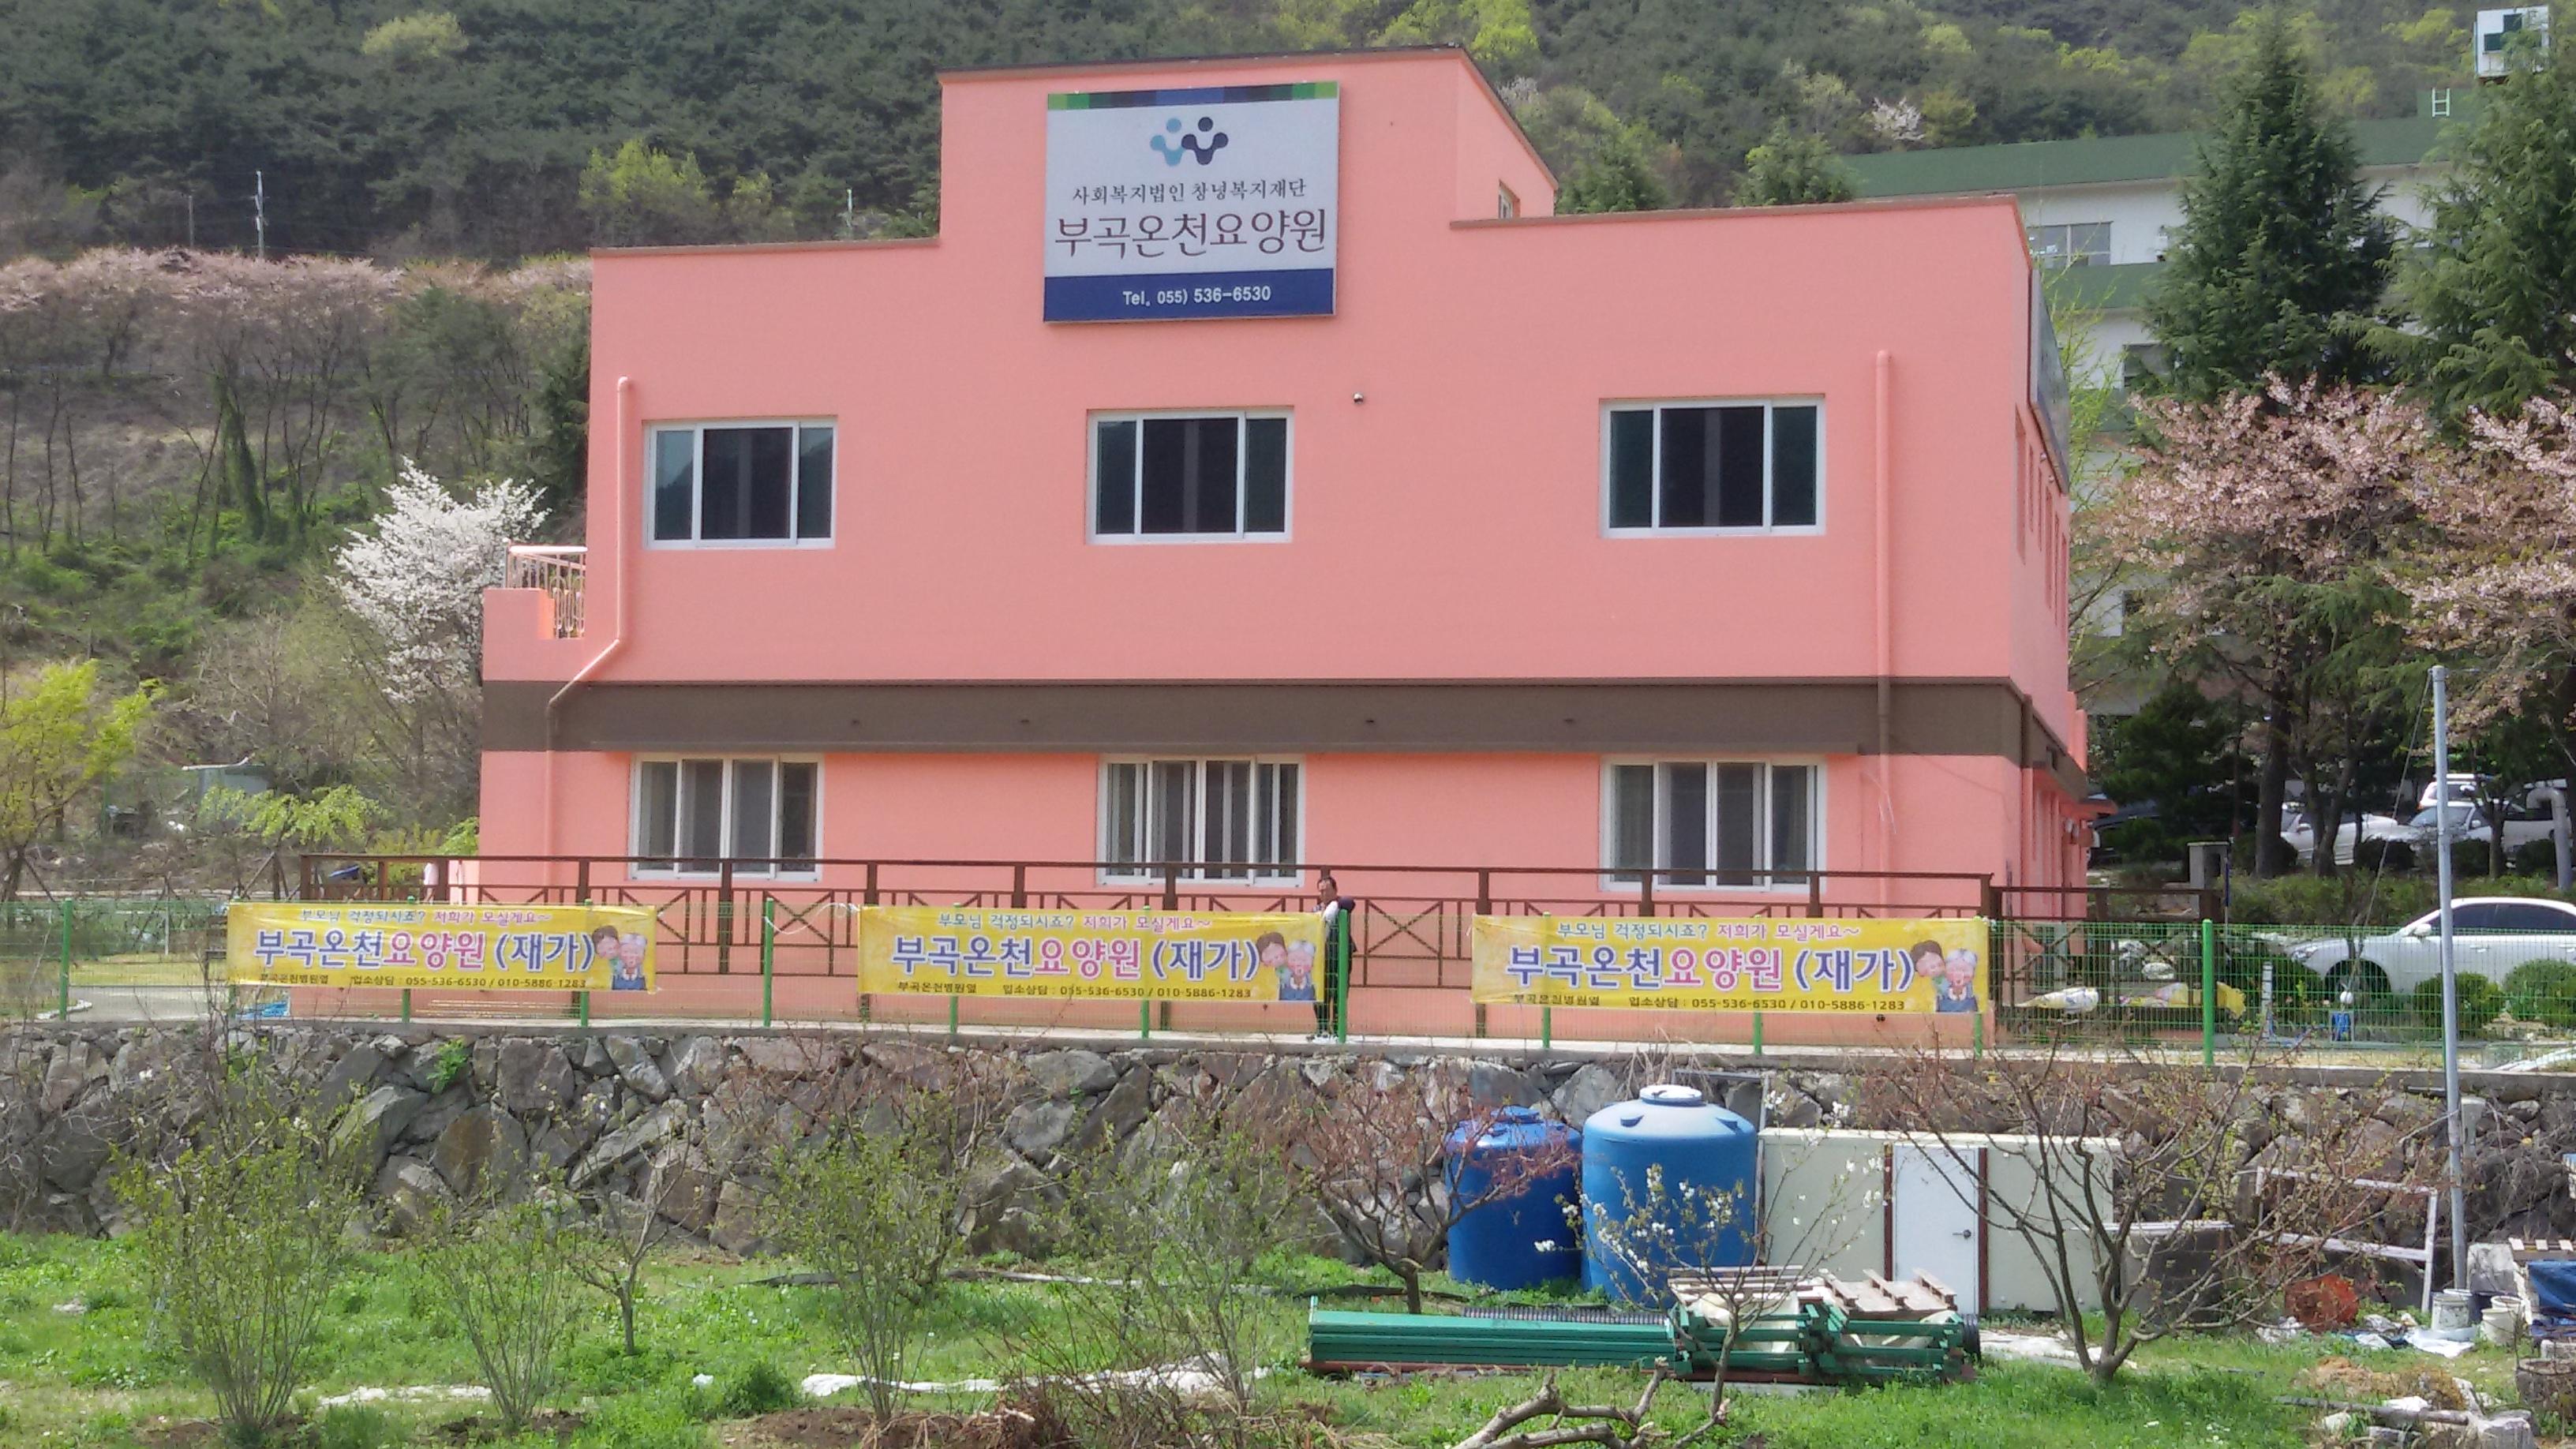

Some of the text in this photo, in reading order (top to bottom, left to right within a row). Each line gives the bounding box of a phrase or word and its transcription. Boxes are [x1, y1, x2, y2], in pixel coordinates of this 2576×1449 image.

[1072, 178, 1307, 205] 사회복지법인 창녕복지재단
[1054, 208, 1327, 260] 부곡온천요양원
[1123, 286, 1271, 306] Tel. 055) 536-6530
[939, 914, 982, 930] 부모님
[1084, 915, 1127, 930] 저희가
[1557, 923, 1605, 939] 부모님
[1615, 923, 1707, 940] 걱정되시죠?
[1718, 924, 1766, 938] 저희가
[256, 930, 593, 970] 부곡온천요양원 (재가)
[893, 936, 1258, 979] 부곡온천요양원 (재가)
[1507, 946, 1913, 990] 부곡온천요양원 (재가)
[1692, 998, 1786, 1009] 055-536-6530
